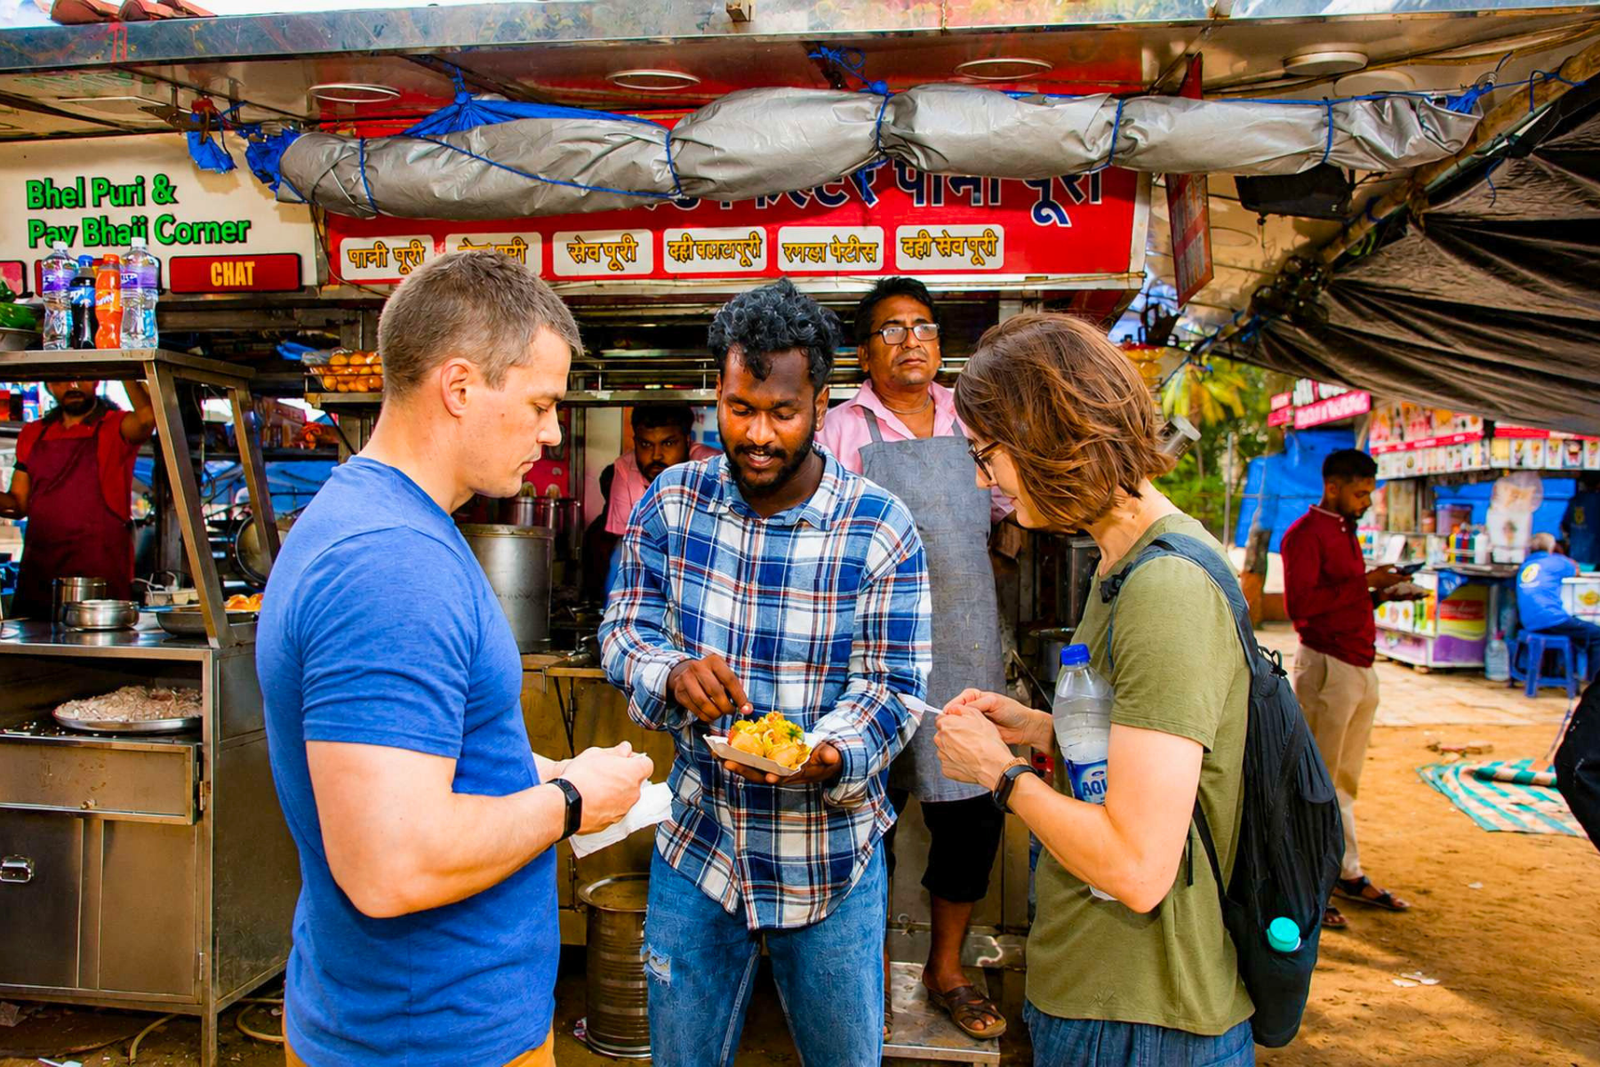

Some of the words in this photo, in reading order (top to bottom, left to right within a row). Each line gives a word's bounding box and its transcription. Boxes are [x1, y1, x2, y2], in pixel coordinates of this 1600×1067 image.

[26, 175, 86, 210] Bhel
[91, 175, 146, 208] Puri
[151, 173, 179, 205] &
[28, 218, 78, 249] Pav
[82, 215, 148, 248] Bhaji
[154, 213, 252, 246] Corner
[901, 229, 933, 260] दही
[933, 229, 966, 257] सेव
[966, 228, 999, 266] पूरी
[347, 240, 389, 269] पानी
[392, 239, 426, 275] पूरी
[566, 235, 601, 264] सेव
[601, 232, 639, 271] पूरी
[210, 261, 256, 287] CHAT
